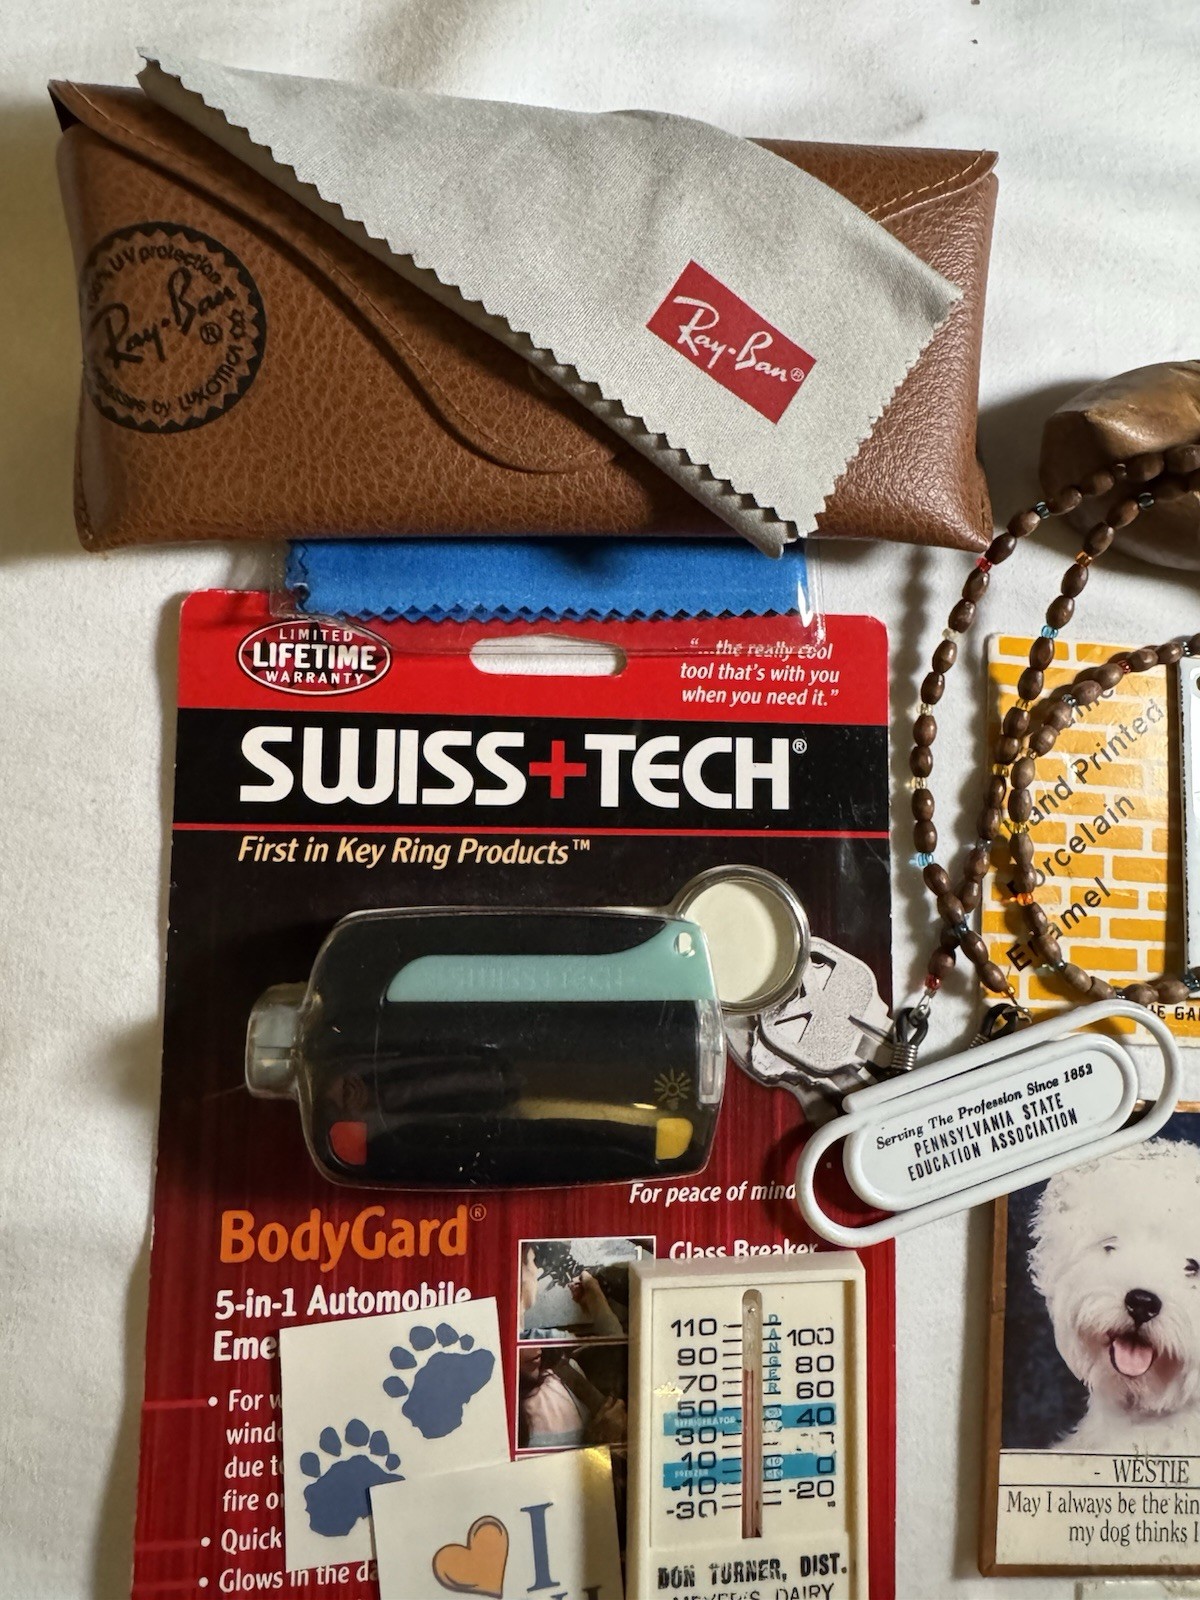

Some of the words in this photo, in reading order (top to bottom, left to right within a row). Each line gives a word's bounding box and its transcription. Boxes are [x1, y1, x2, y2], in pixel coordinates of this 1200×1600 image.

[109, 248, 135, 272] UV
[278, 628, 353, 643] LIMITED
[252, 642, 377, 671] LIFETIME
[747, 641, 793, 662] really
[798, 643, 833, 660] cool
[265, 670, 364, 685] WARRANTY
[680, 662, 714, 679] tool
[718, 662, 765, 681] that’s
[770, 665, 805, 682] with
[808, 670, 840, 686] you
[682, 686, 727, 703] when
[729, 689, 761, 708] you
[766, 689, 808, 706] need
[1003, 775, 1073, 836] and
[1071, 699, 1164, 784] Printed
[238, 836, 299, 863] First
[304, 837, 330, 863] in
[336, 837, 386, 869] Key
[391, 838, 451, 870] Ring
[1007, 795, 1135, 893] orcelain
[1151, 1005, 1166, 1020] E
[1175, 1006, 1200, 1021] GA
[876, 1125, 924, 1150] Serving
[928, 1115, 954, 1130] The
[957, 1090, 1023, 1120] Profession
[1027, 1078, 1059, 1096] Since
[1064, 1063, 1093, 1083] 1852
[914, 1110, 1015, 1158] PENNSYLVANIA
[1022, 1093, 1064, 1120] STATE
[908, 1142, 981, 1181] EDUCATION
[990, 1108, 1078, 1152] ASSOCIATION
[629, 1183, 662, 1204] For
[665, 1185, 722, 1207] peace
[726, 1181, 749, 1201] of
[669, 1240, 726, 1260] Glass
[214, 1287, 297, 1320] 5-in-1
[306, 1281, 472, 1316] Automobile
[671, 1318, 717, 1338] 110
[787, 1327, 835, 1346] 100
[213, 1330, 281, 1361] Eme
[677, 1347, 717, 1366] 90
[768, 1314, 779, 1392] DANGER
[796, 1355, 835, 1373] 80
[678, 1374, 717, 1394] 70
[796, 1380, 835, 1400] 60
[228, 1389, 264, 1412] For
[677, 1400, 717, 1419] 50
[796, 1407, 835, 1427] 40
[675, 1426, 717, 1445] 30
[224, 1455, 264, 1479] due
[682, 1451, 717, 1470] 10
[817, 1456, 835, 1474] 0
[1113, 1459, 1189, 1483] WESTIE
[671, 1476, 717, 1497] -10
[789, 1480, 834, 1499] -20
[222, 1489, 259, 1513] fire
[266, 1492, 285, 1510] o
[666, 1499, 717, 1520] -30
[1006, 1491, 1041, 1517] May
[1047, 1491, 1052, 1513] I
[1058, 1491, 1112, 1518] always
[1118, 1492, 1136, 1514] be
[1143, 1492, 1169, 1514] the
[1174, 1493, 1200, 1515] kin
[220, 1526, 282, 1555] Quick
[1069, 1525, 1094, 1546] my
[1100, 1519, 1130, 1547] dog
[1136, 1520, 1188, 1543] thinks
[1194, 1521, 1199, 1542] I
[520, 1502, 560, 1594] I
[219, 1568, 283, 1593] Glows
[288, 1569, 309, 1587] in
[316, 1564, 350, 1585] the
[658, 1564, 696, 1589] DON
[800, 1553, 848, 1577] DIST.
